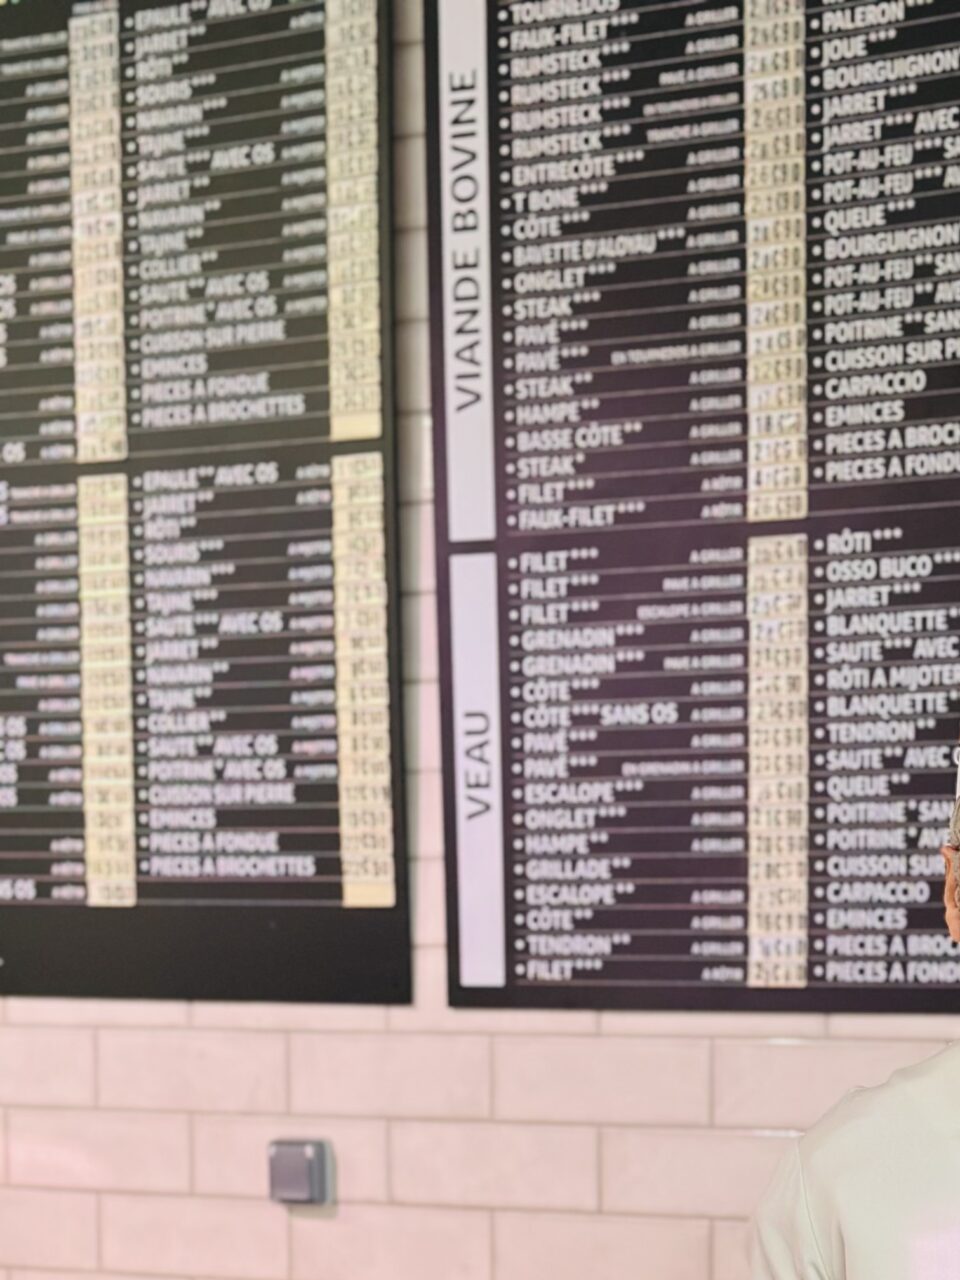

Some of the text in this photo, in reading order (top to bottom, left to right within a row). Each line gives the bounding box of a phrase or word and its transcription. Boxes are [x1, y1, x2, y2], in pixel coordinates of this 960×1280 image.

[450, 69, 481, 412] VIANDE BOVINE
[905, 338, 943, 364] SUR
[824, 368, 926, 400] CARPACCIO
[824, 429, 886, 455] PIECES
[887, 427, 903, 449] A
[824, 457, 886, 483] PIECES
[887, 455, 903, 477] A
[465, 712, 492, 821] VEAU
